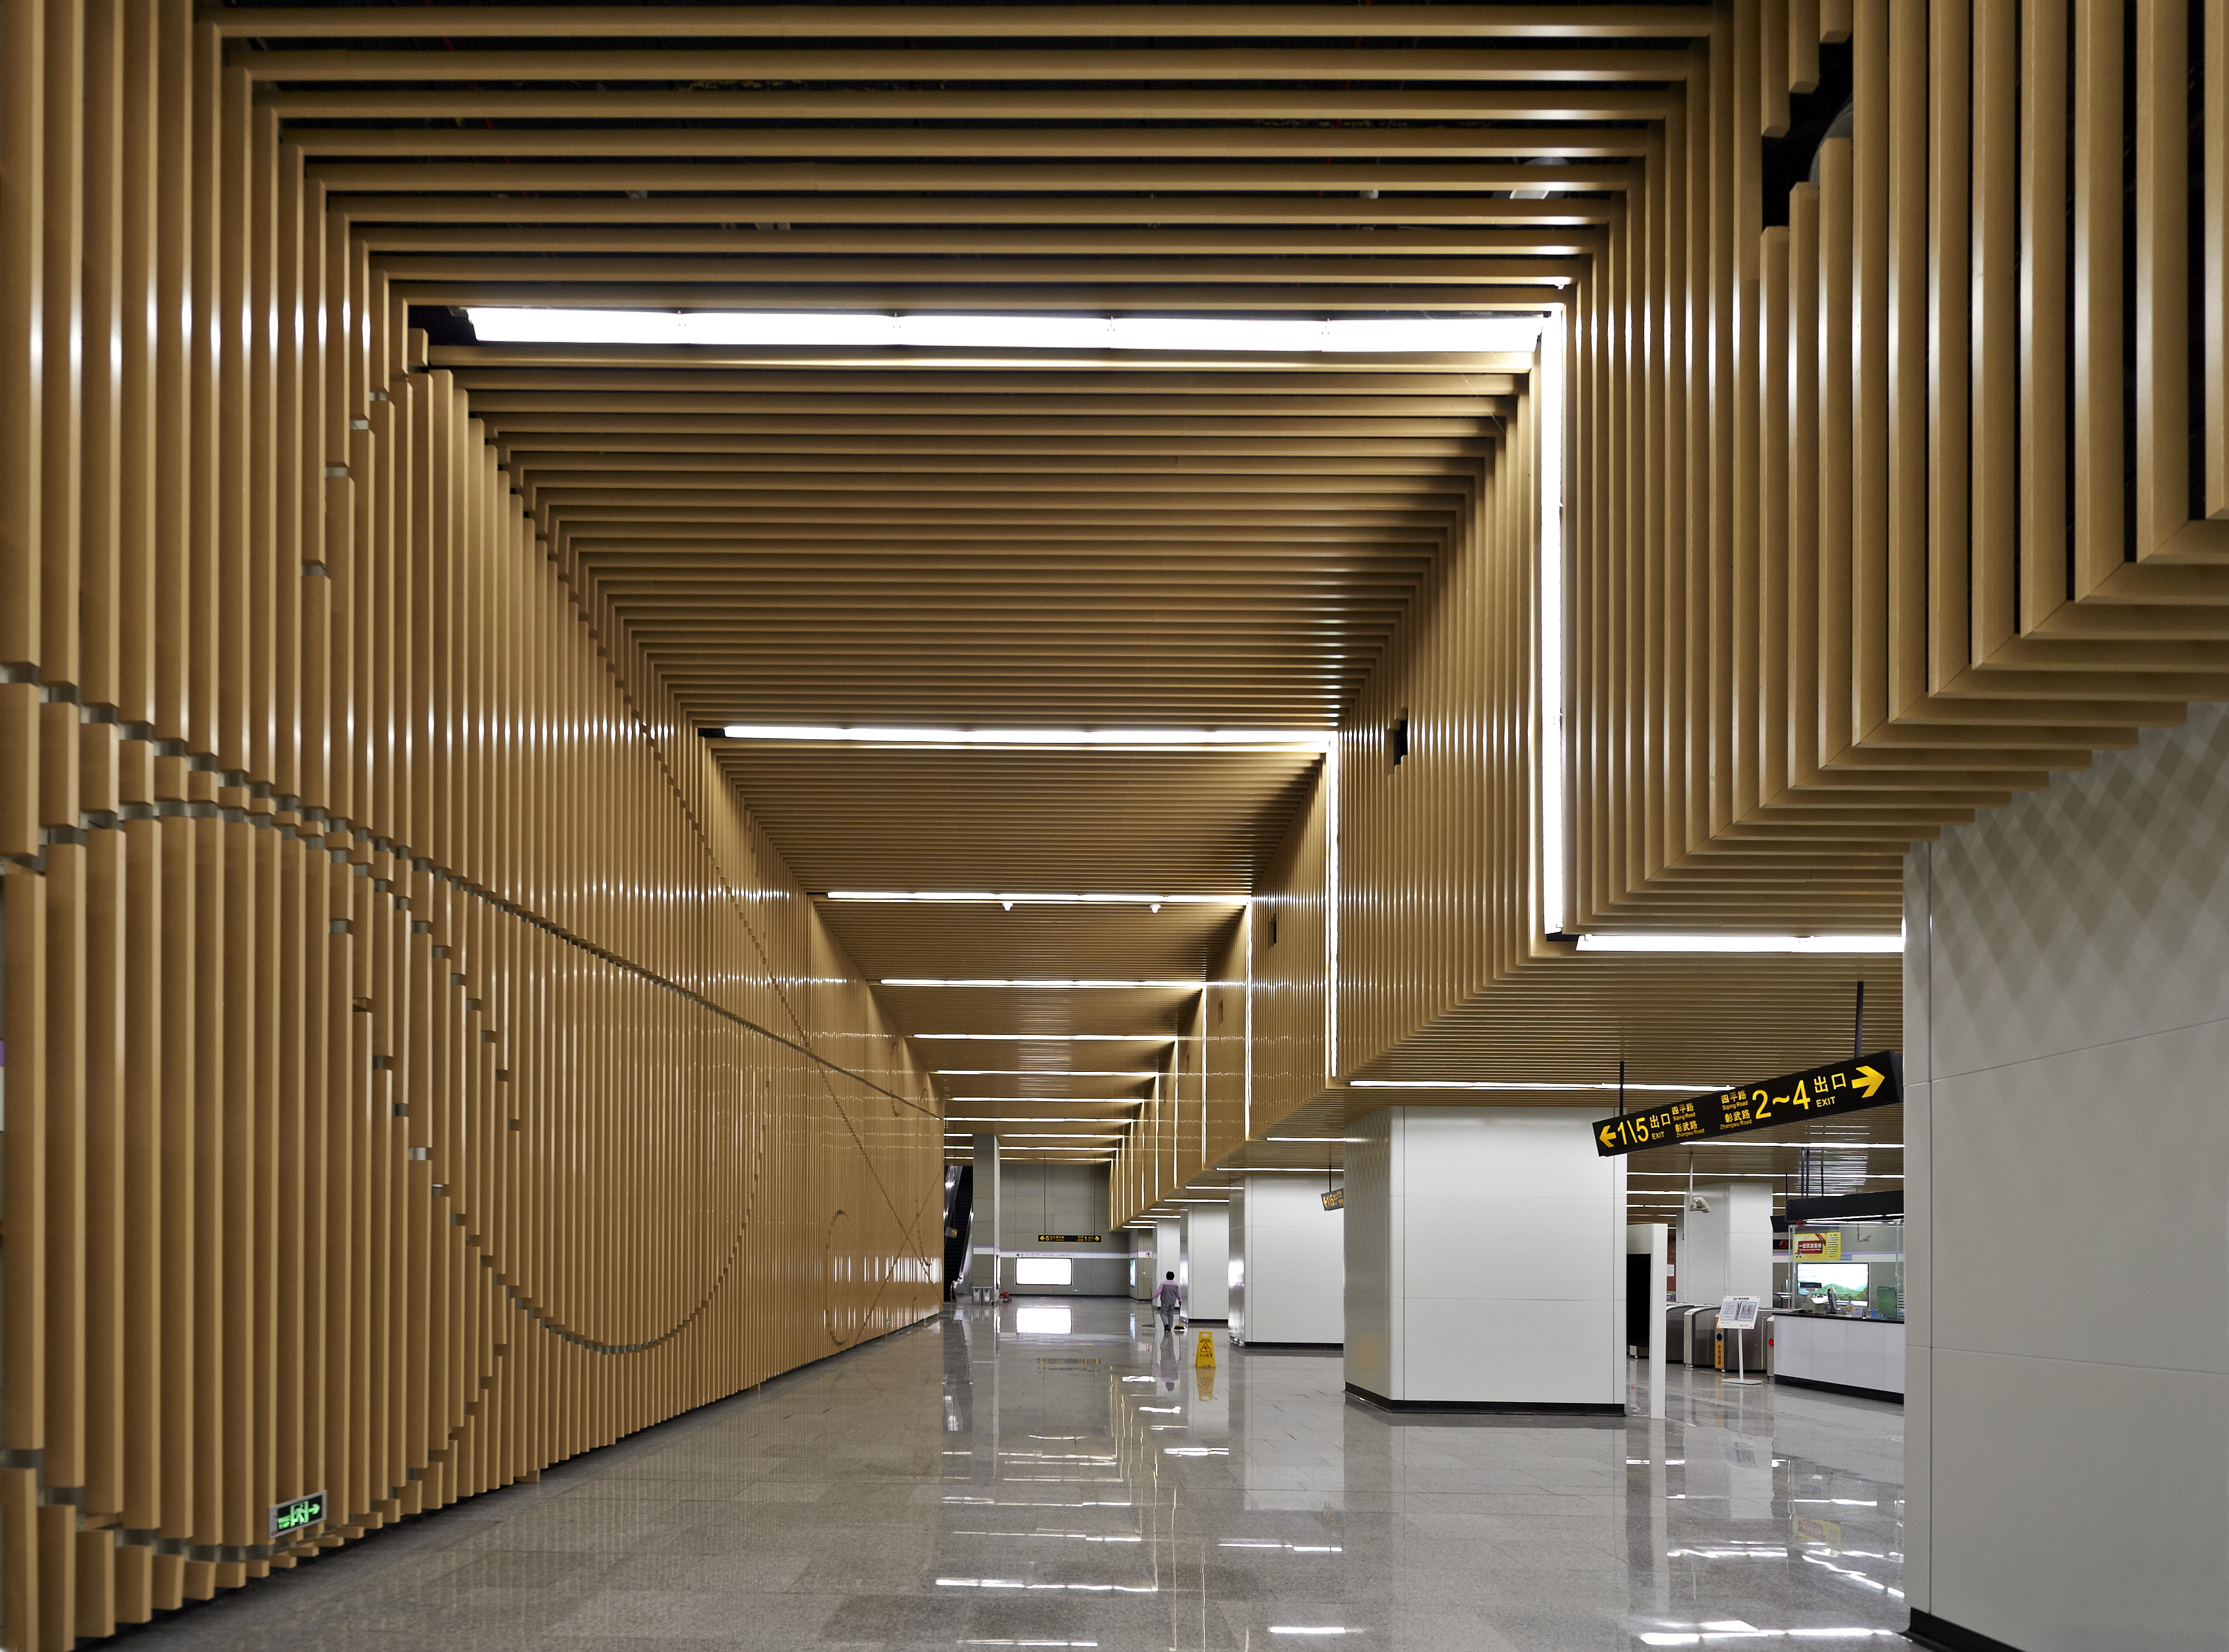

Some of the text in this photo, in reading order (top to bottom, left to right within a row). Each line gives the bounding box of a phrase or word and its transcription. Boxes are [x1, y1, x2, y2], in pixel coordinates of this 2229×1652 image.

[1813, 1073, 1846, 1093] 出口
[1720, 1090, 1747, 1104] 四平路
[1816, 1096, 1836, 1108] EXIT
[1671, 1102, 1694, 1115] 四平路
[1722, 1100, 1749, 1111] Siping Road
[1650, 1113, 1671, 1129] 出口
[1725, 1109, 1750, 1123] 彰武路
[1675, 1120, 1698, 1133] 彰武路
[1651, 1131, 1665, 1140] EXIT
